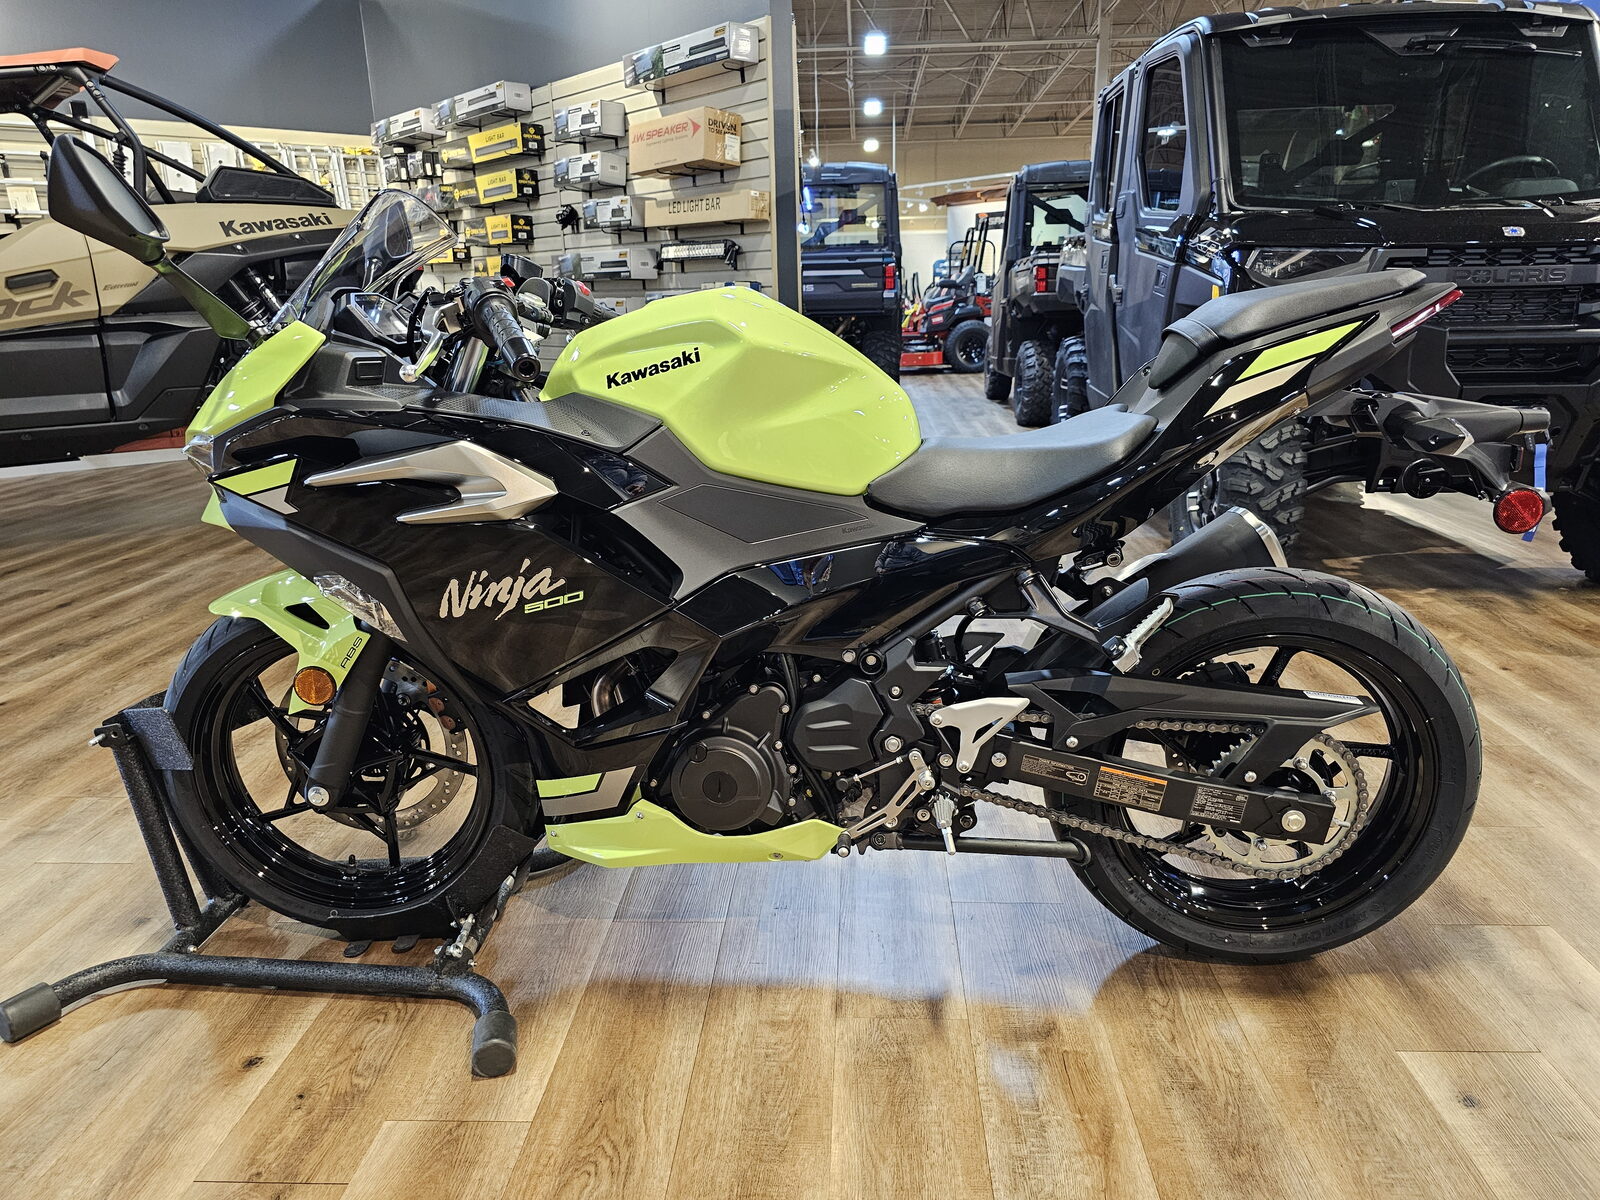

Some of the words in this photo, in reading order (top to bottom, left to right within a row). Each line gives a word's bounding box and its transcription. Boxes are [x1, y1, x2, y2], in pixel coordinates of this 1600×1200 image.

[485, 134, 496, 143] LIGHT
[497, 132, 505, 140] BAR
[668, 201, 681, 214] LED
[683, 199, 704, 213] LIGHT
[705, 197, 721, 211] BAR
[219, 212, 333, 238] Kawasaki
[1453, 268, 1567, 284] POLARIS
[605, 346, 701, 390] Kawasaki
[439, 558, 566, 621] Ninja
[524, 590, 584, 614] 500
[340, 636, 363, 669] ABS
